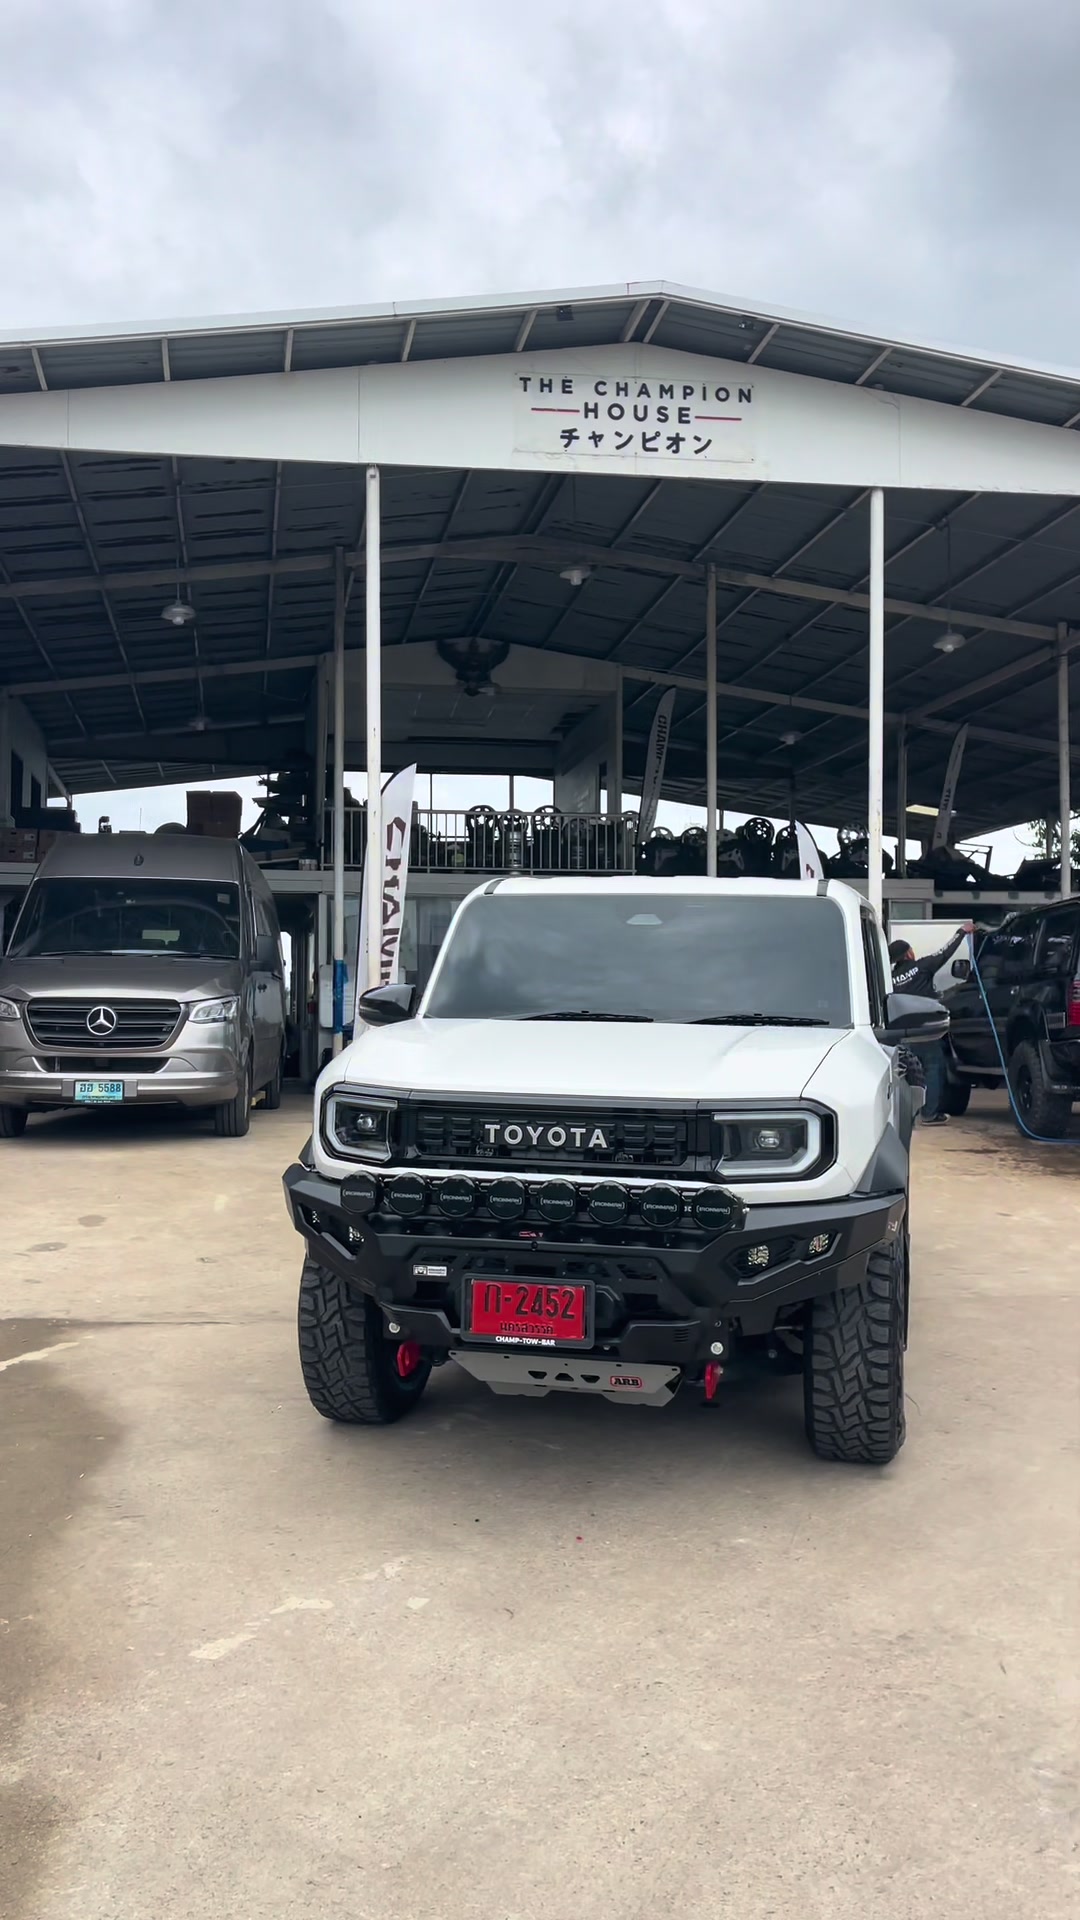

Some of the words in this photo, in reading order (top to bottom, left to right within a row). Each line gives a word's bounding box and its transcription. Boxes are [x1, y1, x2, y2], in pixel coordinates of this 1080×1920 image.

[519, 377, 574, 395] THE
[594, 380, 752, 404] CHAMPION
[584, 402, 692, 425] HOUSE
[560, 427, 712, 455] チャンピオン
[892, 966, 919, 985] HAMP
[98, 1083, 121, 1092] 5588
[485, 1124, 608, 1149] TOYOTA
[484, 1284, 576, 1320] ก-2452
[495, 1336, 556, 1346] CHAMP-TOW-BAR
[614, 1377, 640, 1386] ARB
